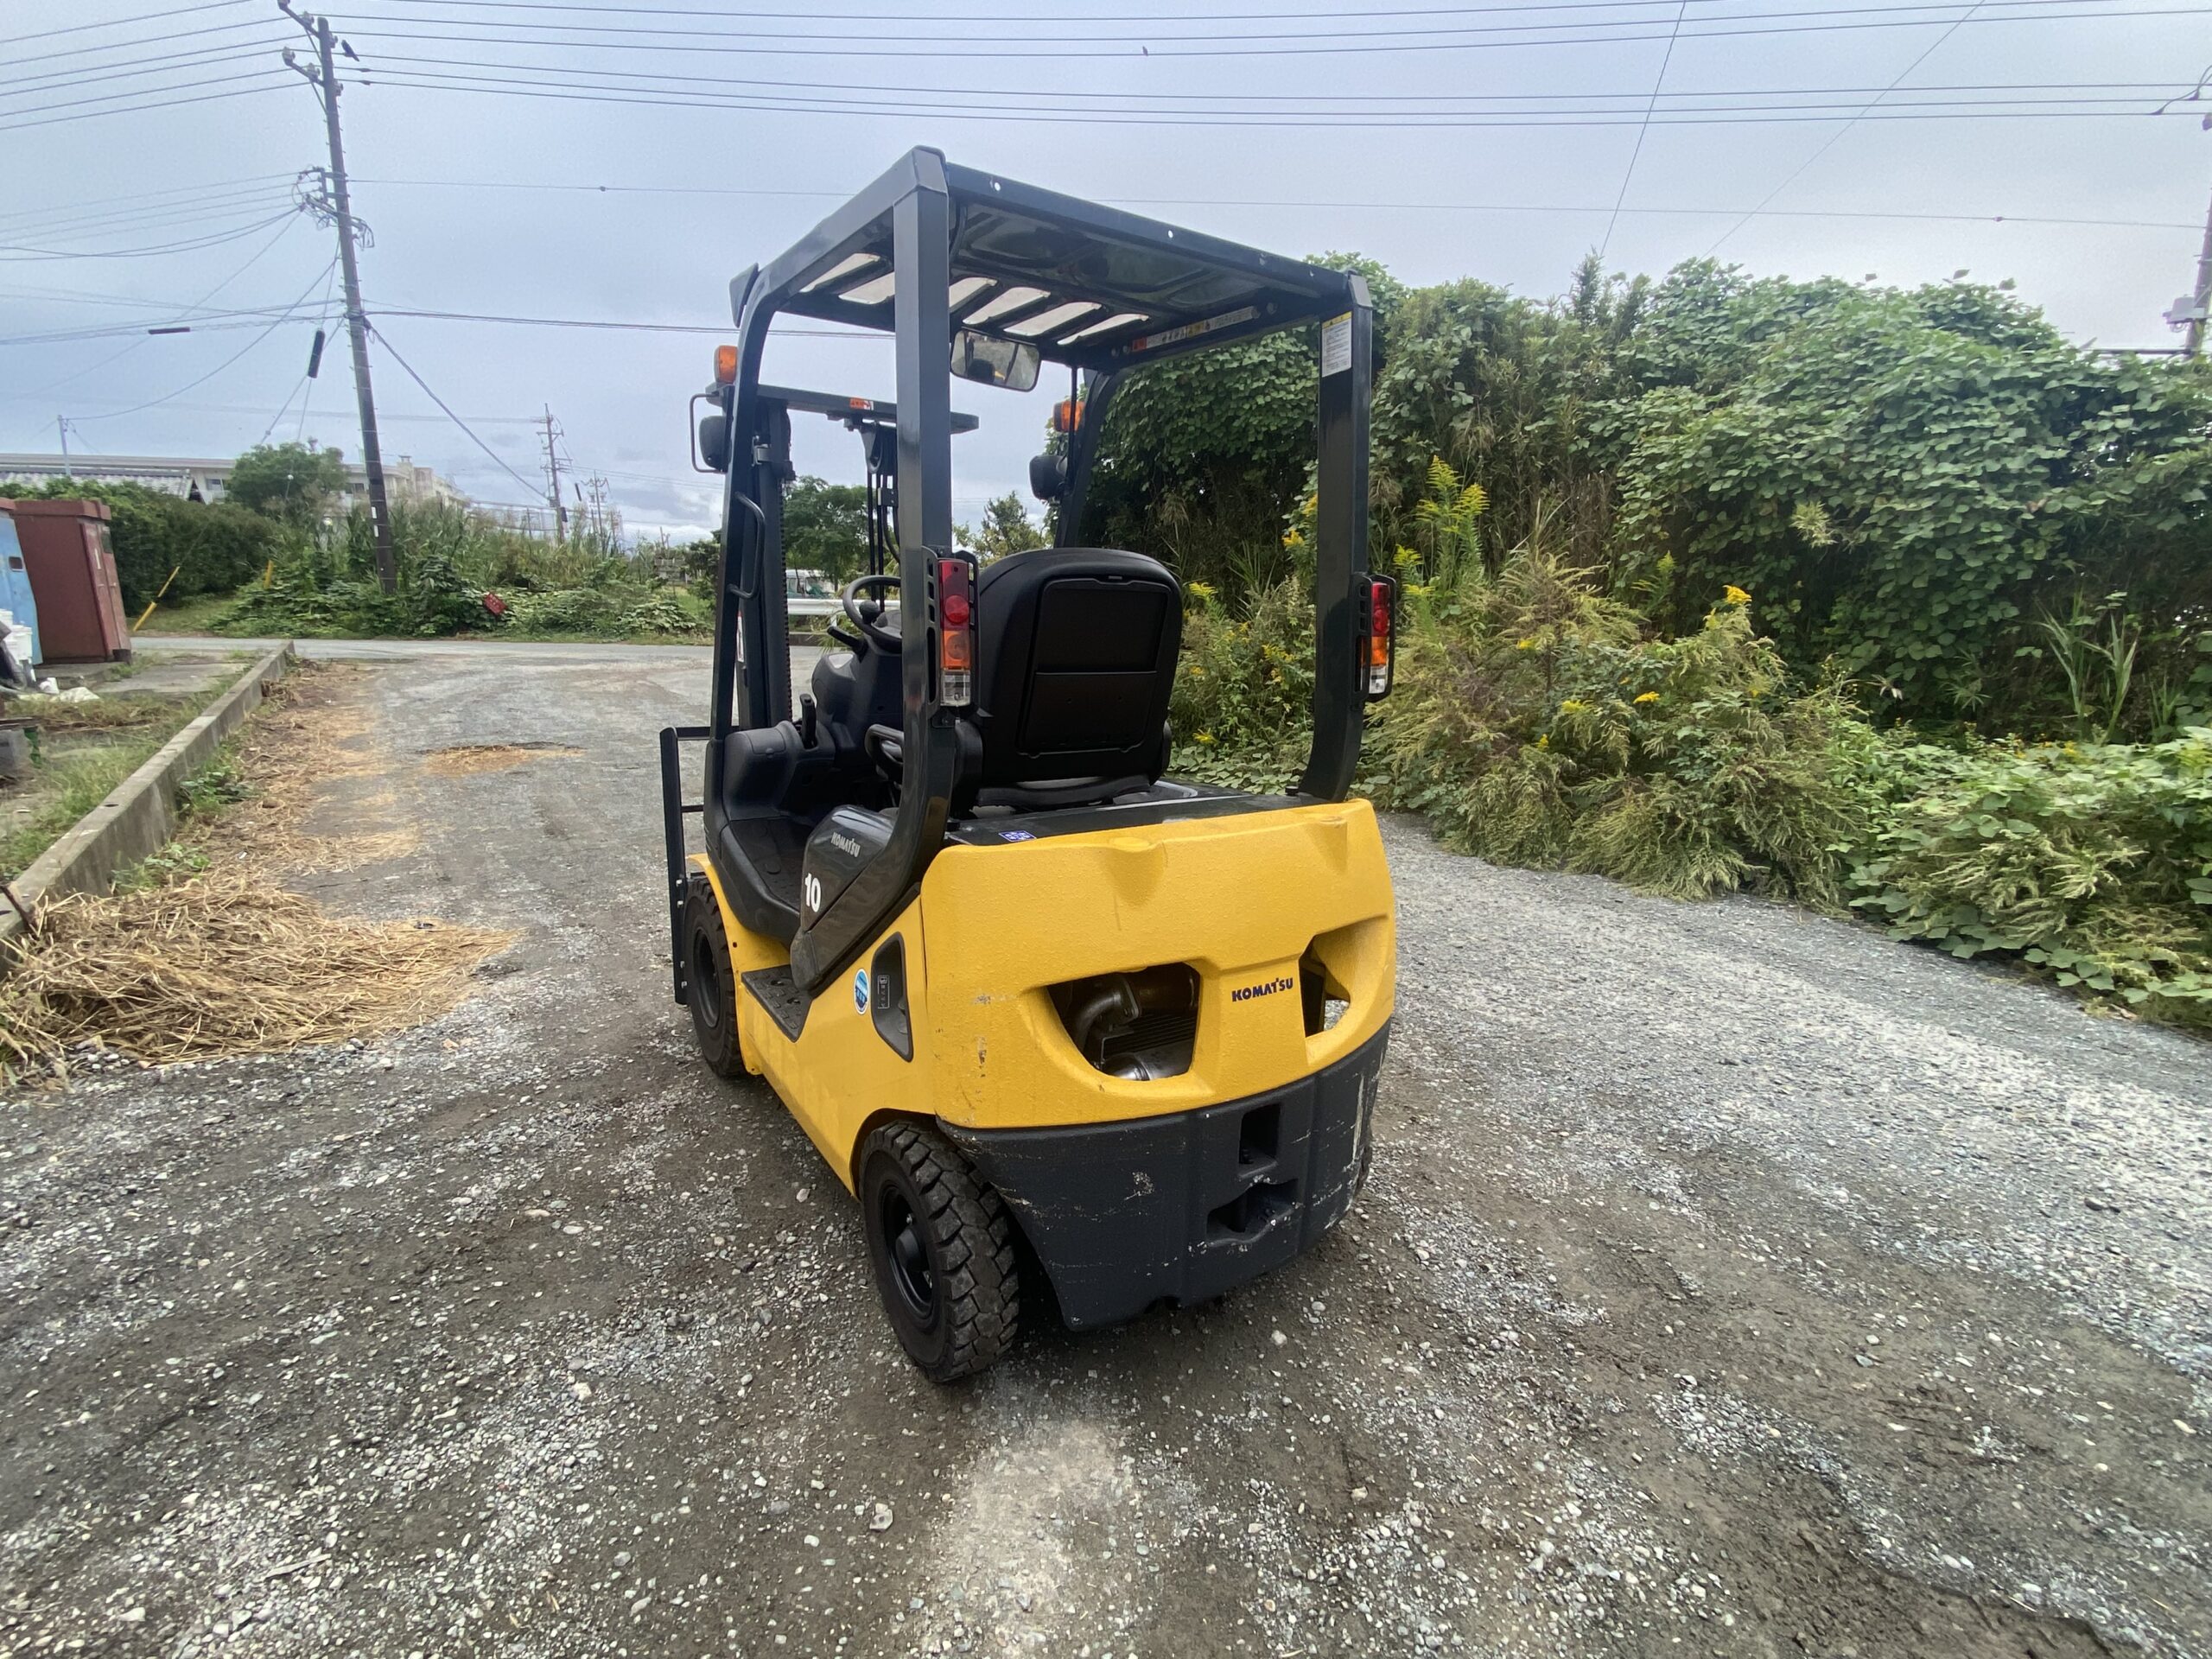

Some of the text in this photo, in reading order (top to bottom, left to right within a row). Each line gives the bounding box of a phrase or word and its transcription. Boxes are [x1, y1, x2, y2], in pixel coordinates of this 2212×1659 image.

[830, 832, 861, 858] KOMATSU
[804, 873, 822, 912] 10
[1231, 977, 1294, 1002] KOMATSU
